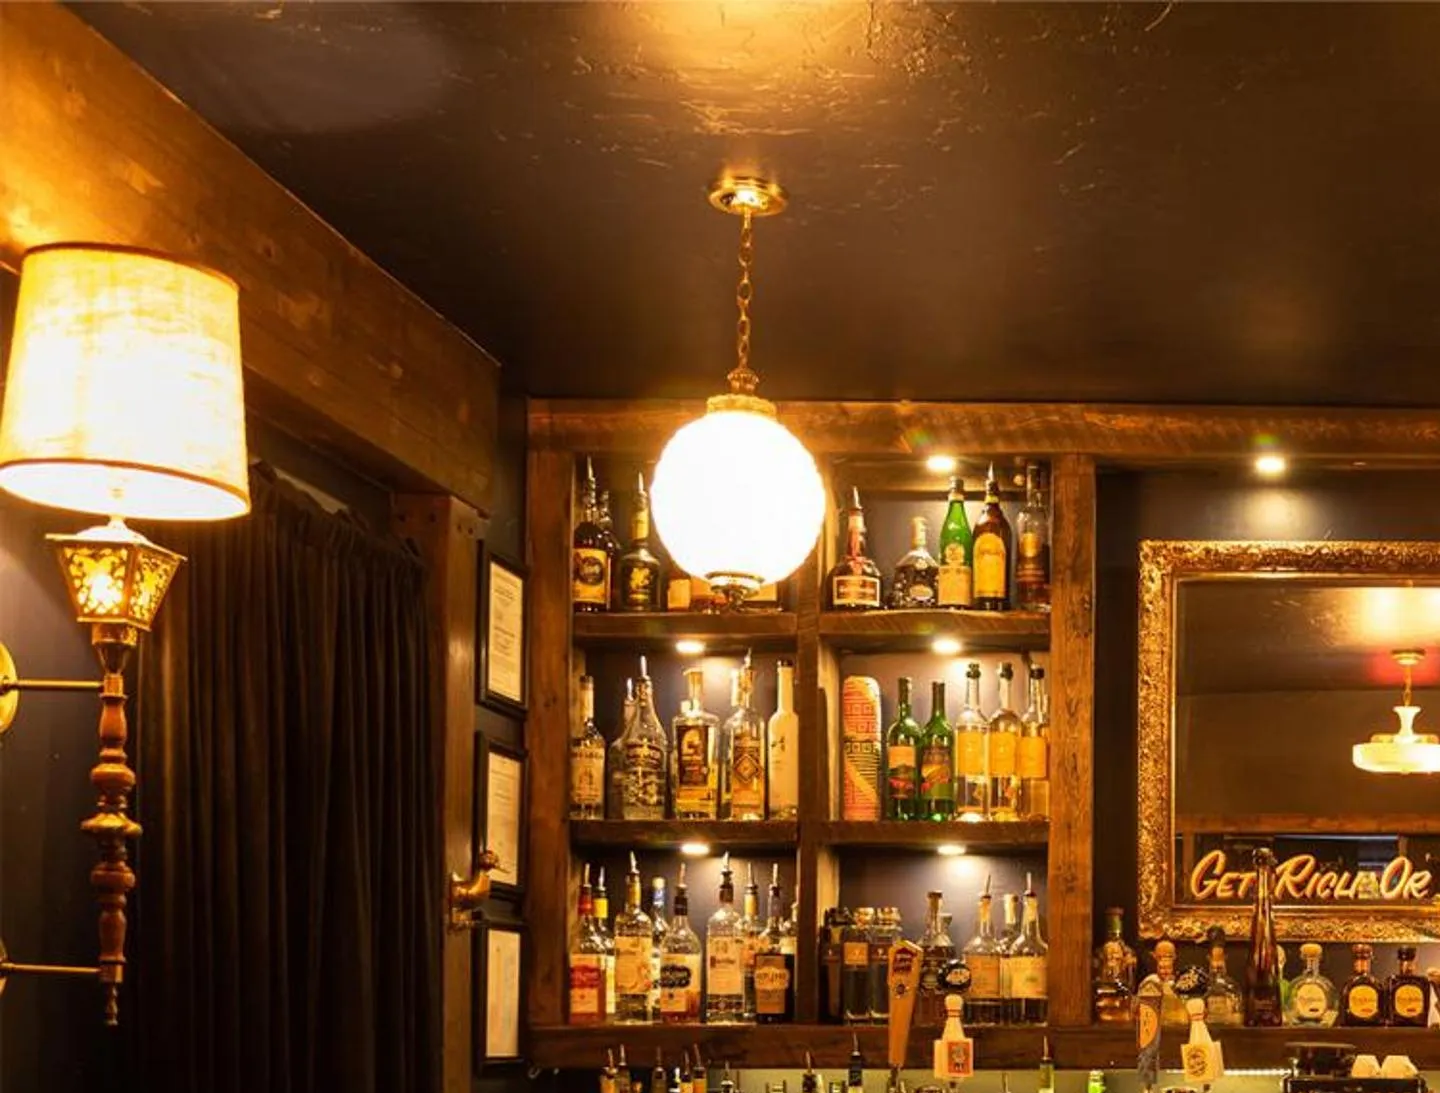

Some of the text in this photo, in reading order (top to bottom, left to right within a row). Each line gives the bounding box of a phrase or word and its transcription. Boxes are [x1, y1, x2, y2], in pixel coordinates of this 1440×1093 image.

[1191, 850, 1257, 900] GET
[1274, 854, 1364, 900] RICH
[1380, 856, 1432, 899] OR
